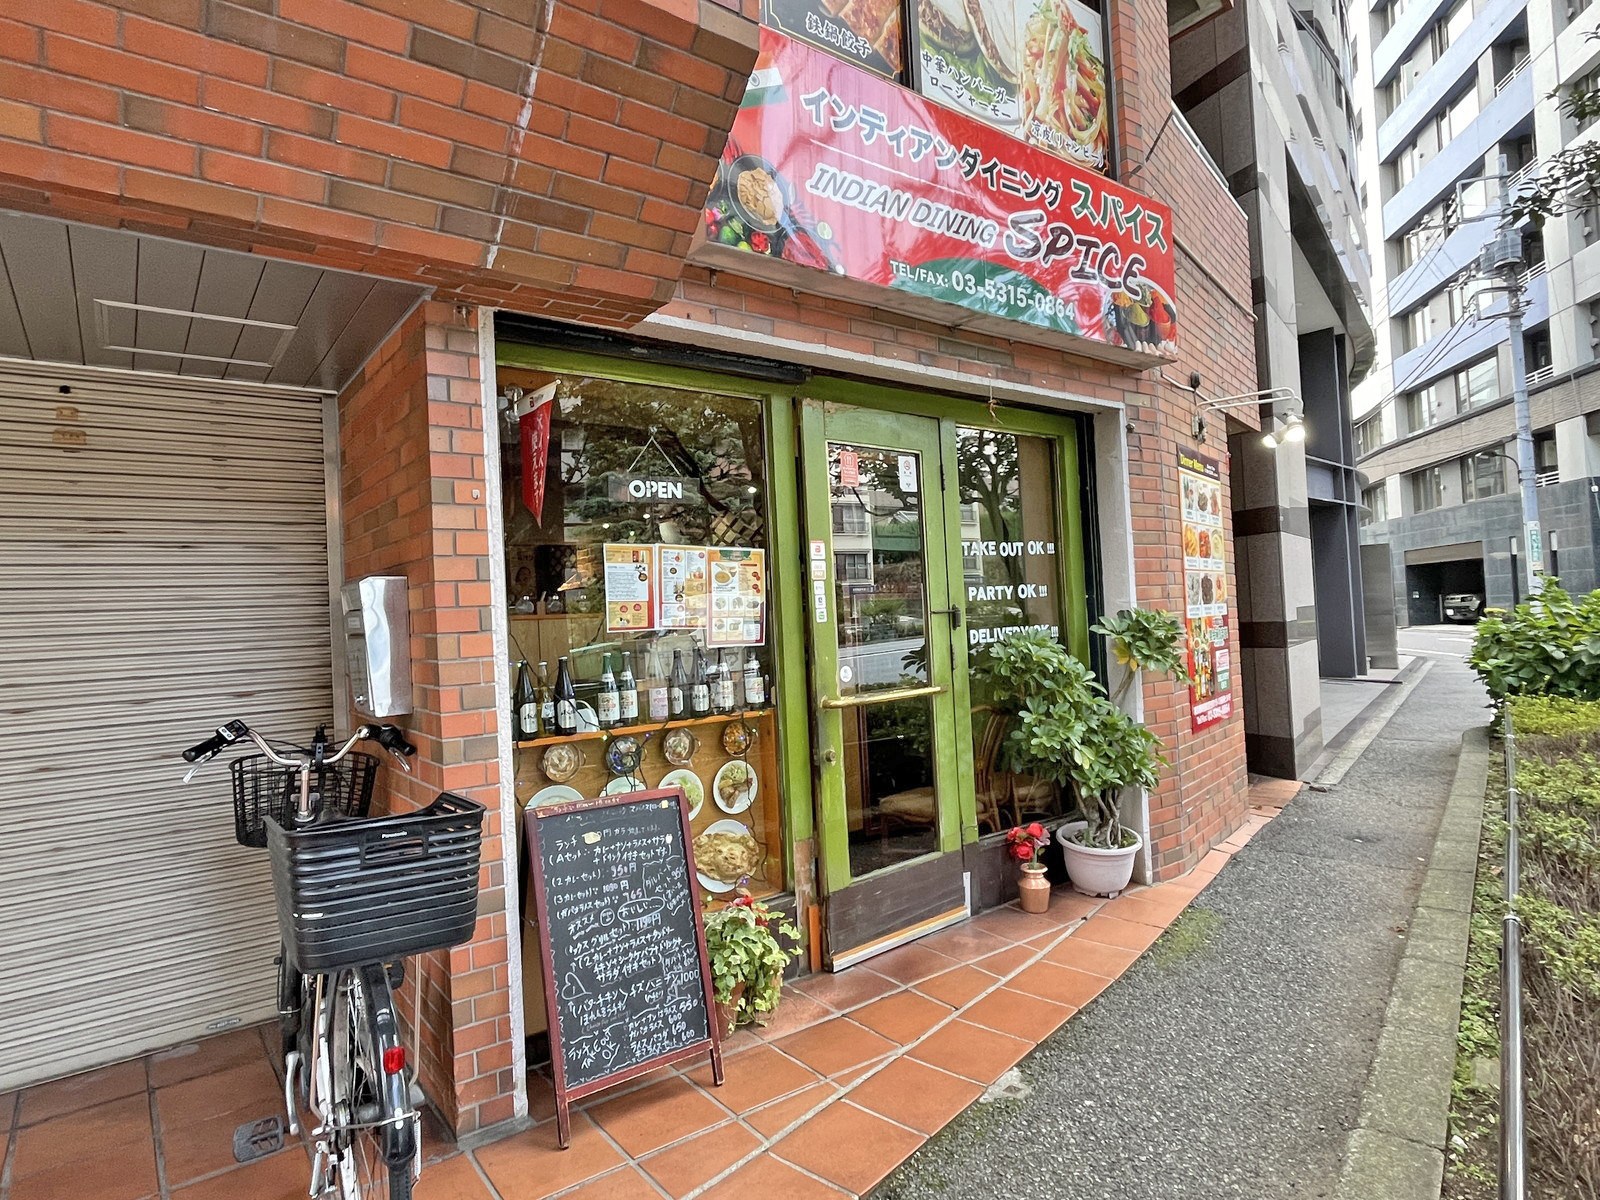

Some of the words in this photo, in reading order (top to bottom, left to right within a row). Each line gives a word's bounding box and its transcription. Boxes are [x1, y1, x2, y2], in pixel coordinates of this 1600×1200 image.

[921, 50, 1016, 104] 中華ハンバーガー
[929, 76, 1011, 119] ロージャーモー
[802, 88, 1061, 208] インディアンダイニング
[1072, 181, 1166, 252] スパイス
[808, 166, 911, 220] INDIAN
[912, 201, 997, 247] DINING
[1004, 211, 1145, 299] SPICE
[890, 260, 948, 288] TEL/FAX:
[952, 271, 1075, 320] 03-5315-0864
[628, 479, 682, 499] OPEN
[962, 541, 996, 556] TAKE
[1000, 542, 1024, 556] OUT
[1028, 541, 1044, 555] OK
[968, 585, 1013, 601] PARTY
[1018, 584, 1037, 599] OK
